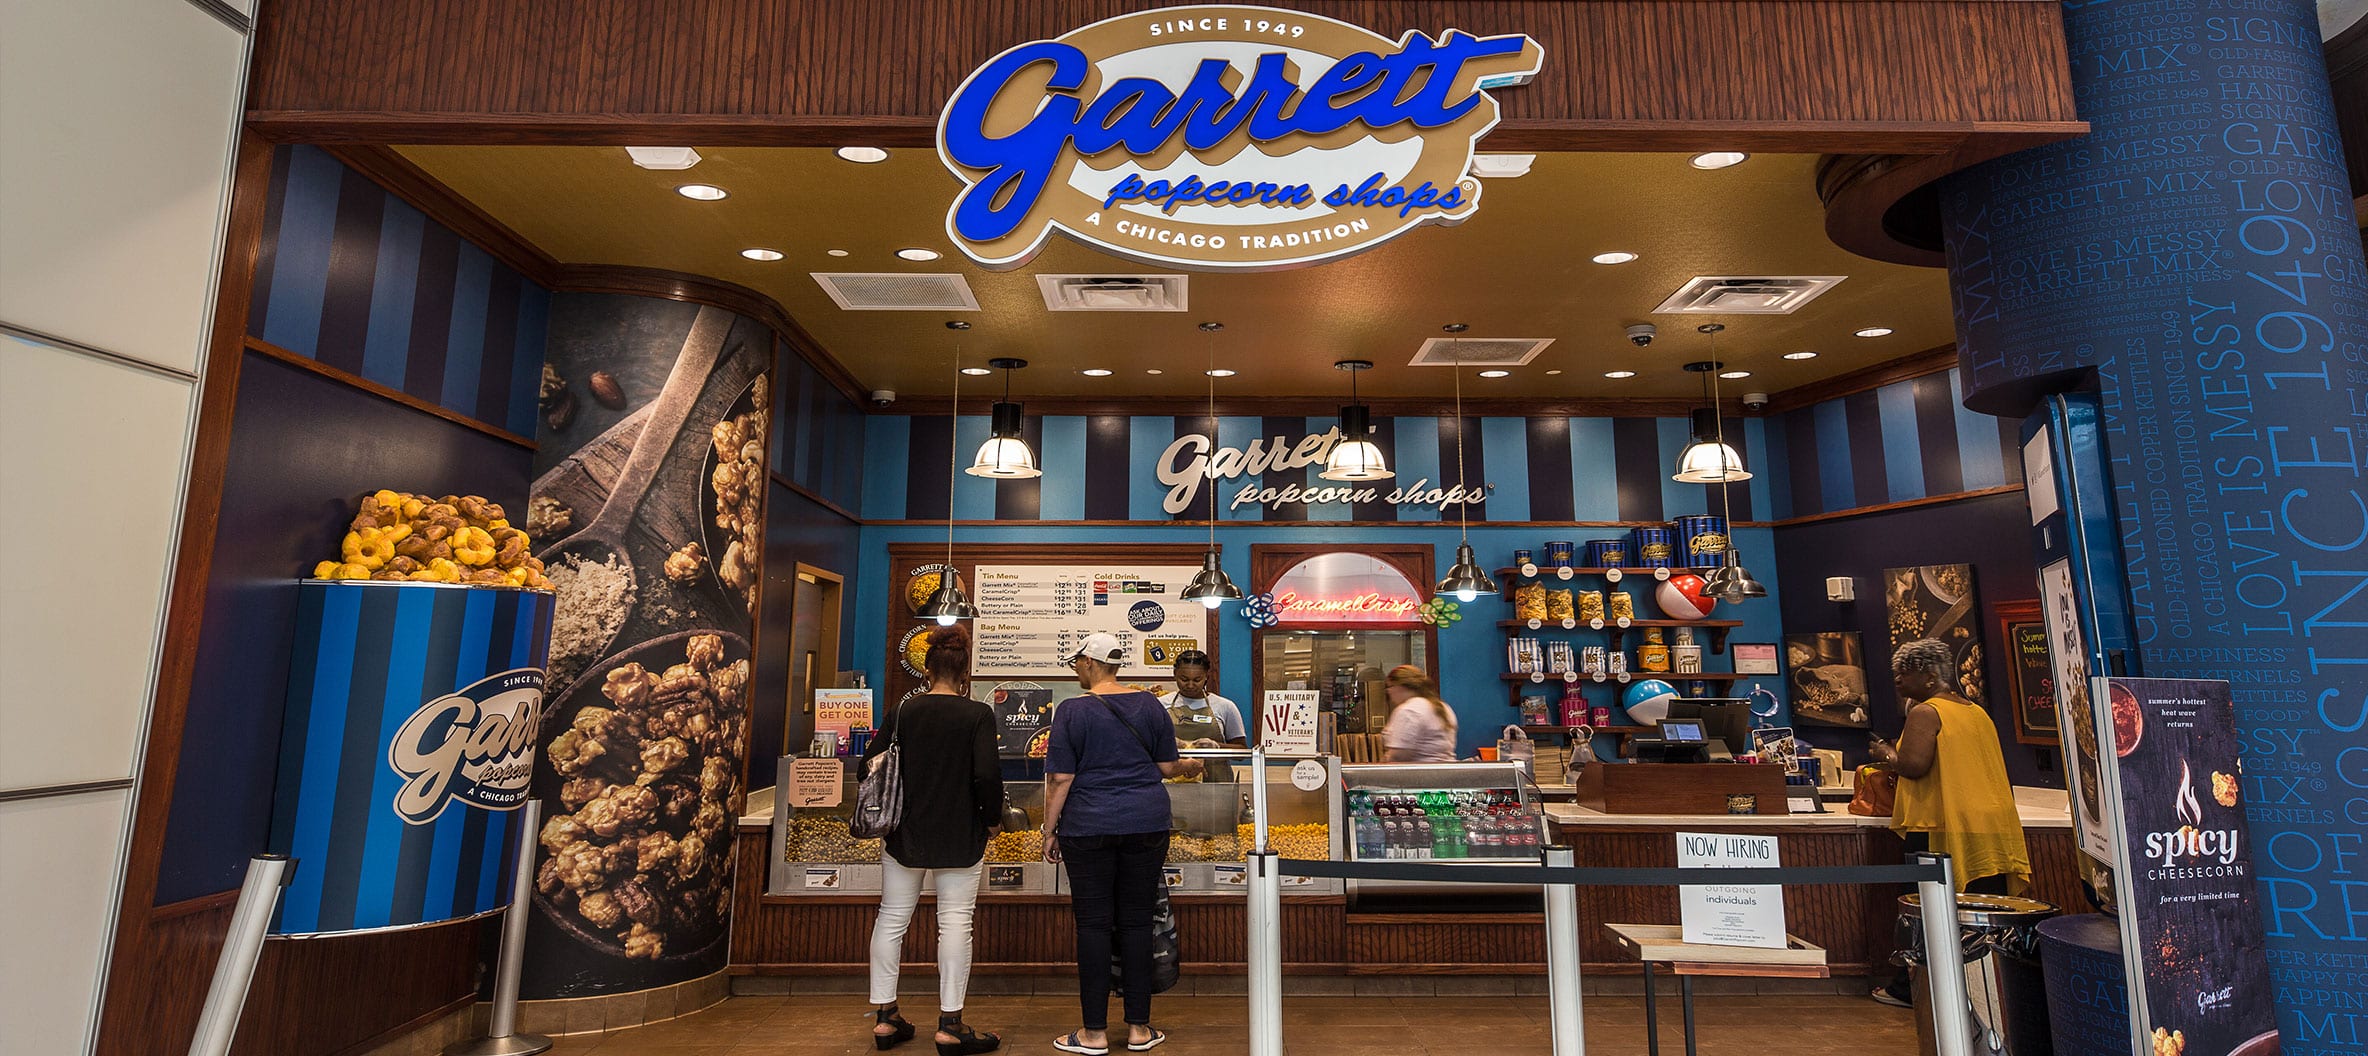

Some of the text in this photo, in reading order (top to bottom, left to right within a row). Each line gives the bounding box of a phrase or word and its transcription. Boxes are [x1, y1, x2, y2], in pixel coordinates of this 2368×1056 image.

[1149, 17, 1305, 40] SINCE 1949
[2110, 70, 2201, 91] KERNELS
[2110, 87, 2209, 108] SINCE 1949
[2128, 102, 2213, 121] KETTLES
[944, 31, 1526, 241] Garrett
[2065, 149, 2091, 171] IS
[1103, 172, 1312, 216] popcorn
[1990, 178, 2132, 227] GARRETT
[2150, 193, 2222, 210] KERNELS
[2231, 179, 2349, 222] LOVE
[2162, 206, 2229, 220] KETTLES
[1085, 212, 1370, 250] A CHICAGO TRADITION
[1999, 228, 2226, 281] LOVE IS MESSY
[2000, 257, 2139, 300] GARRETT
[2238, 215, 2336, 391] 1949
[2127, 337, 2156, 411] KETTLES
[2136, 413, 2167, 486] COPPER
[1157, 424, 1377, 514] Garret
[2162, 310, 2231, 637] A CHICAGO TRADITION SINCE 1949
[2213, 454, 2269, 496] IS
[1230, 478, 1487, 512] popcorn shops
[911, 563, 943, 577] GARRETT
[2222, 510, 2295, 637] LOVE
[1278, 591, 1415, 616] CaramelCrisp
[980, 624, 996, 632] Bag
[504, 675, 531, 688] SINCE
[820, 701, 868, 710] BUY ONE
[1269, 693, 1282, 701] U.S.
[2148, 697, 2207, 706] summer's hottest
[2232, 690, 2308, 704] ETTLES
[819, 711, 868, 719] GET ONE
[1005, 714, 1040, 724] spicy
[1292, 711, 1300, 721] &
[2162, 708, 2177, 717] heat
[2167, 721, 2194, 729] returns
[395, 696, 540, 816] Garr
[2281, 760, 2323, 774] 1949
[467, 787, 515, 802] A CHICAGO
[2246, 808, 2336, 825] ERNELS
[1685, 836, 1770, 860] NOW HIRING
[2145, 827, 2239, 868] spicy
[2267, 831, 2363, 875] OF
[2147, 865, 2244, 881] CHEESECORN
[1705, 885, 1757, 895] OUTGOING
[1705, 894, 1757, 906] individuals
[2159, 894, 2173, 906] for
[2180, 895, 2197, 905] very
[2197, 891, 2222, 902] limited
[2223, 890, 2240, 900] time
